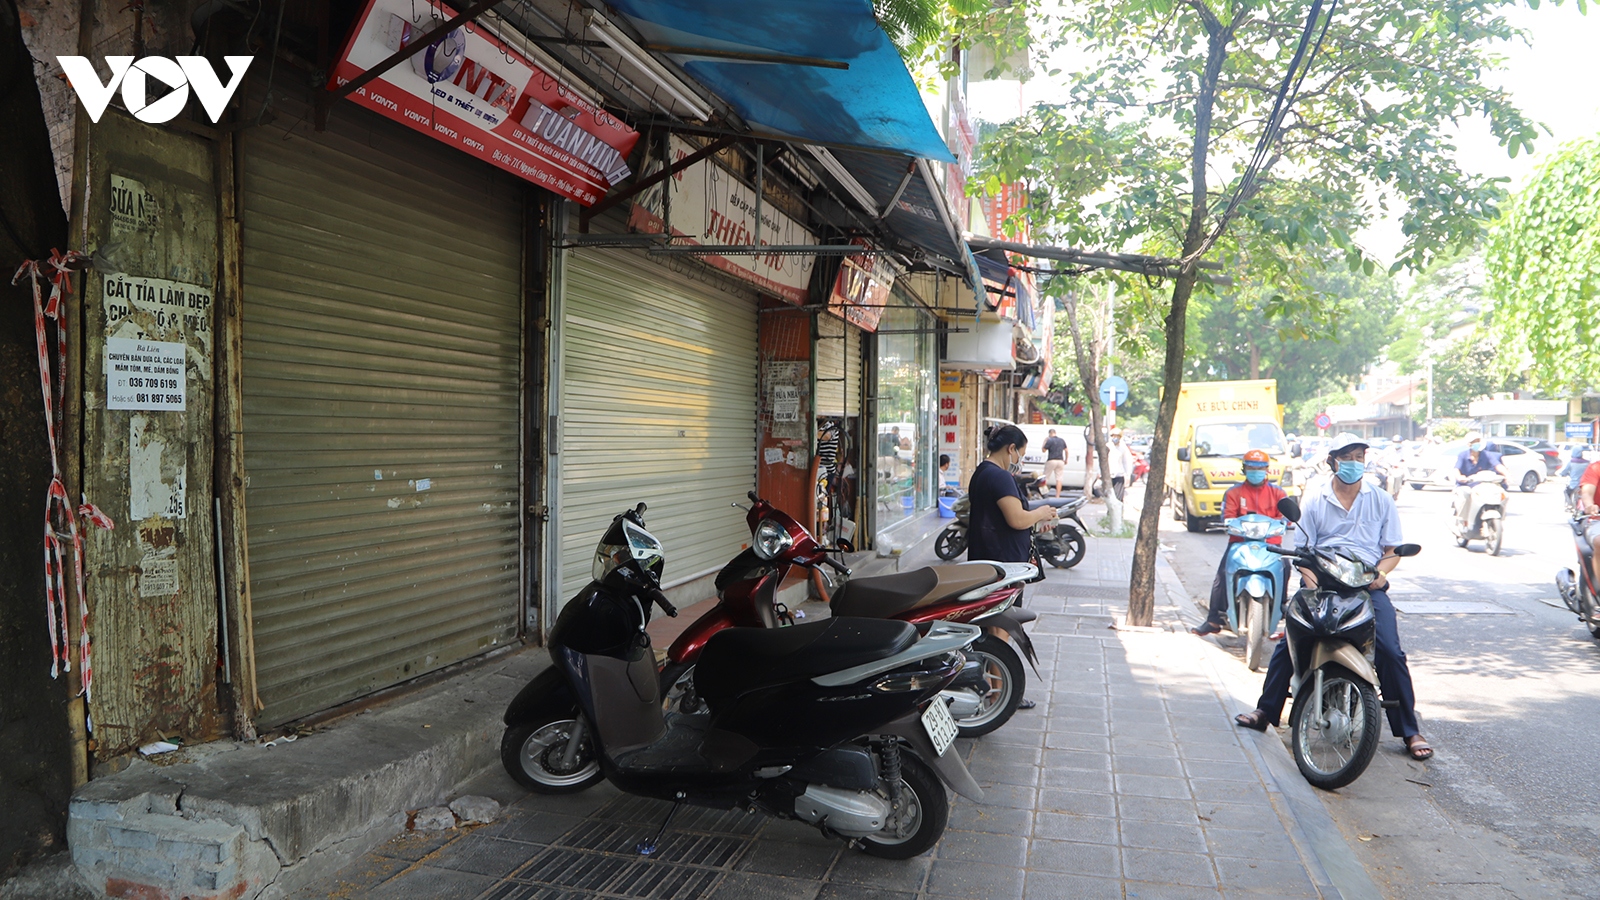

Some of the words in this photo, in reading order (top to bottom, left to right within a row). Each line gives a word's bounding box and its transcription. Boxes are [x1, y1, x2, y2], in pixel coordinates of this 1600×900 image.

[430, 87, 447, 99] LED
[447, 95, 453, 103] &
[370, 92, 398, 111] VONTA
[403, 108, 430, 126] VONTA
[434, 122, 458, 139] VONTA
[462, 136, 485, 152] VONTA
[580, 136, 632, 187] MINH
[107, 276, 132, 299] CẮT
[136, 279, 155, 303] TỈA
[160, 286, 185, 307] LÀM
[188, 292, 210, 313] ĐẸP
[109, 353, 130, 361] CHUYÊN
[129, 377, 143, 388] 036
[145, 378, 159, 388] 709
[160, 379, 177, 389] 6199
[136, 393, 149, 403] 081
[151, 394, 164, 403] 897
[165, 394, 182, 404] 5065
[1196, 402, 1207, 412] XE
[926, 700, 946, 732] 29-B1
[933, 716, 957, 752] 913.22
